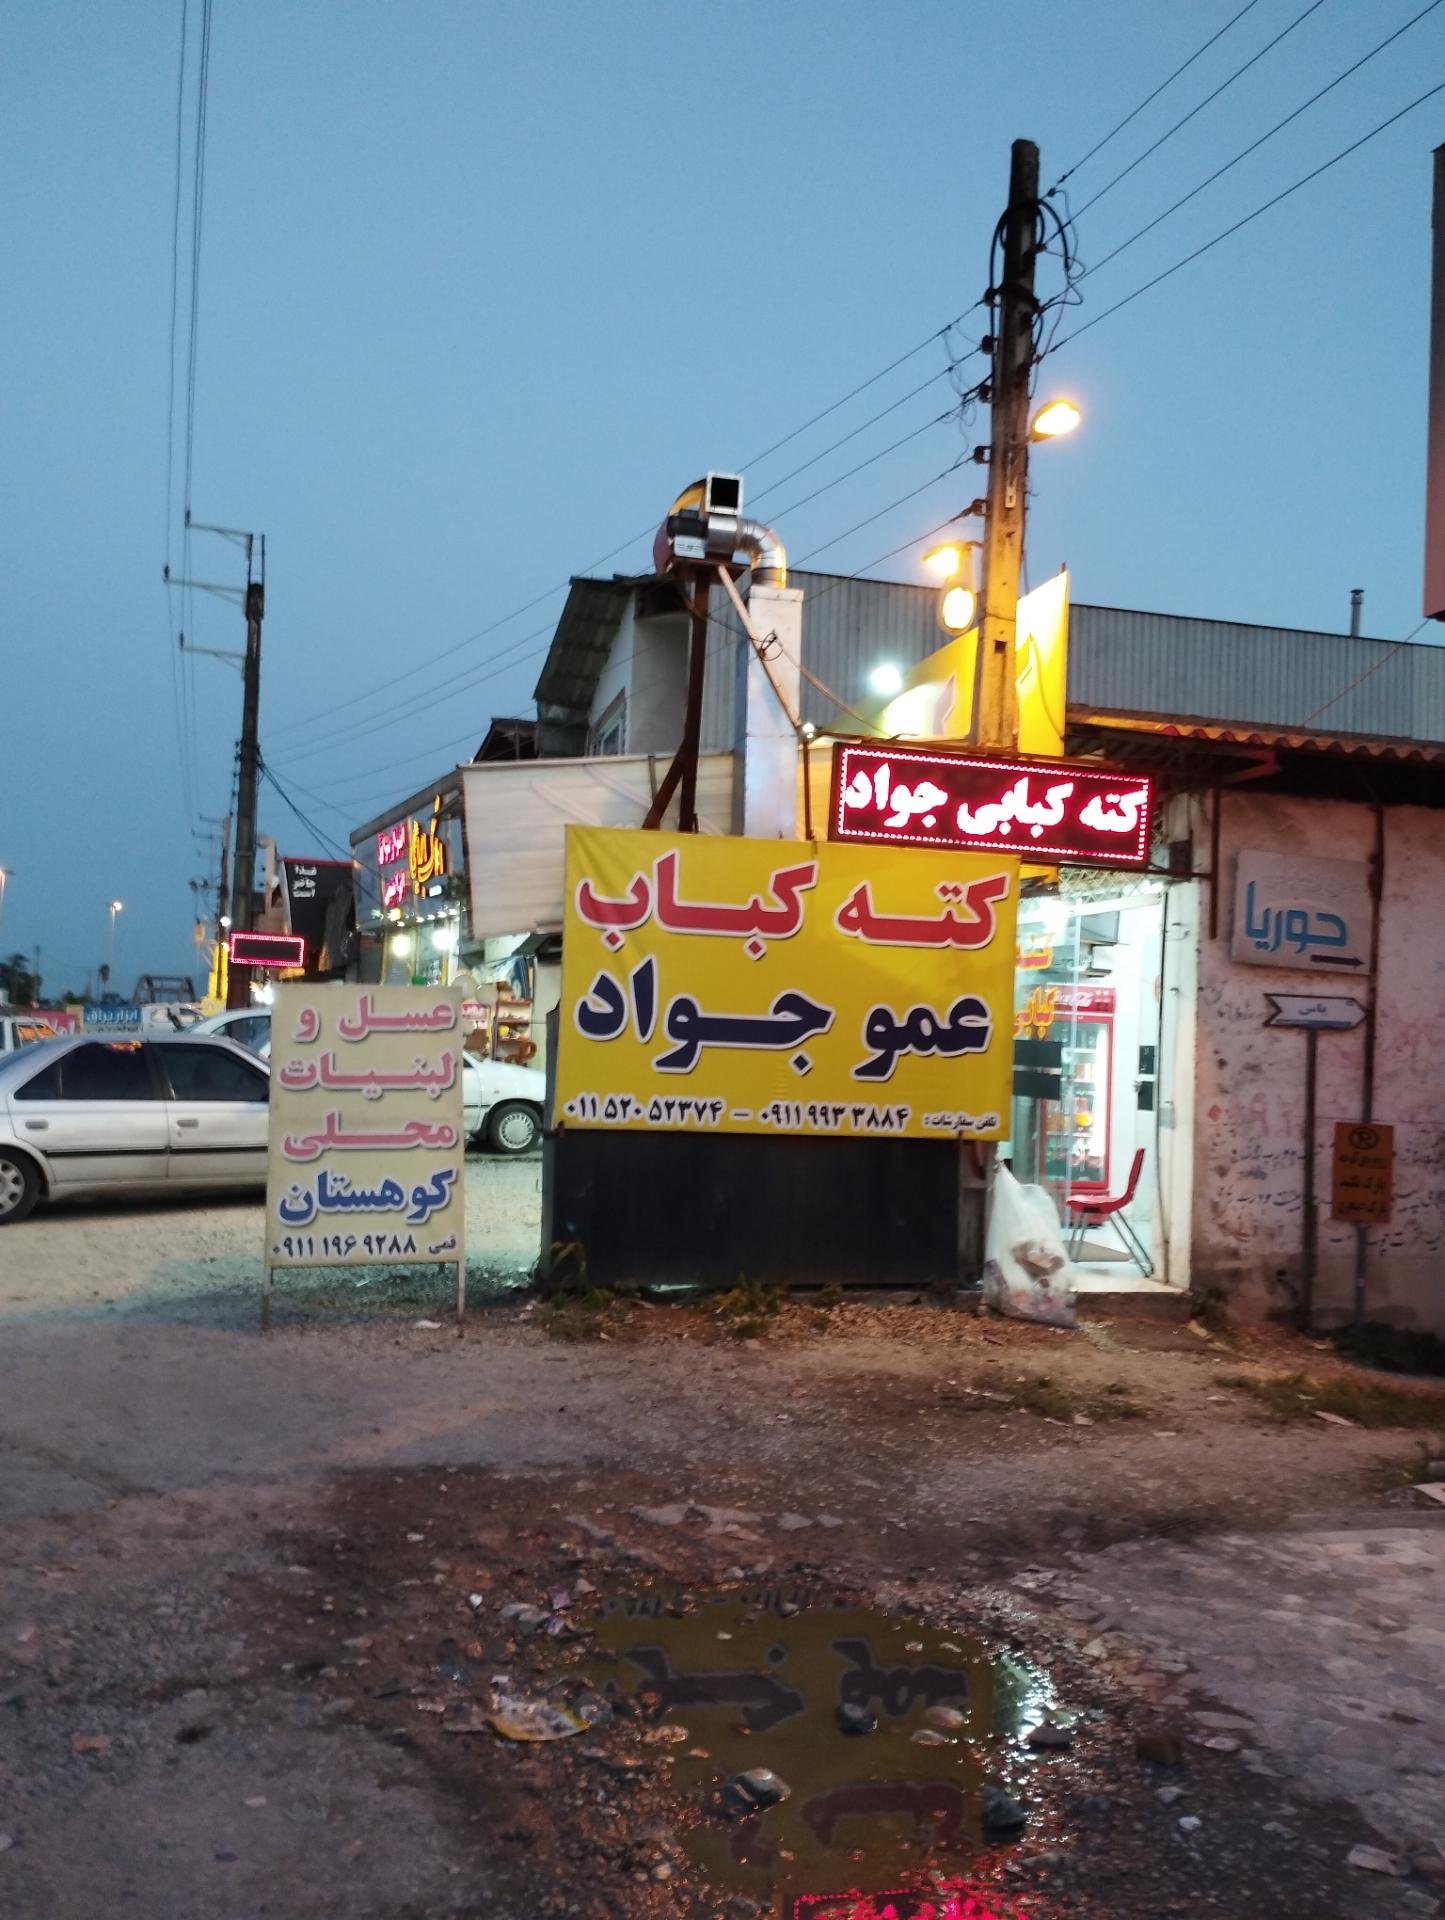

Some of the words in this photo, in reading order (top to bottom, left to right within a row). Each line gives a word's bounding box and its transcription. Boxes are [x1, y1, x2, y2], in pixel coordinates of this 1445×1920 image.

[845, 762, 948, 828] جواد
[956, 776, 1074, 838] کبابی
[1079, 788, 1148, 833] کته
[577, 850, 817, 957] کباب
[838, 874, 1006, 947] کته
[1246, 881, 1347, 954] حوریا
[295, 1007, 320, 1042] و
[340, 996, 455, 1040] عسل
[577, 958, 832, 1074] جواد
[854, 996, 990, 1078] عمو
[280, 1052, 456, 1099] لبنیات
[284, 1112, 456, 1161] محلی
[279, 1169, 456, 1225] کوهستان
